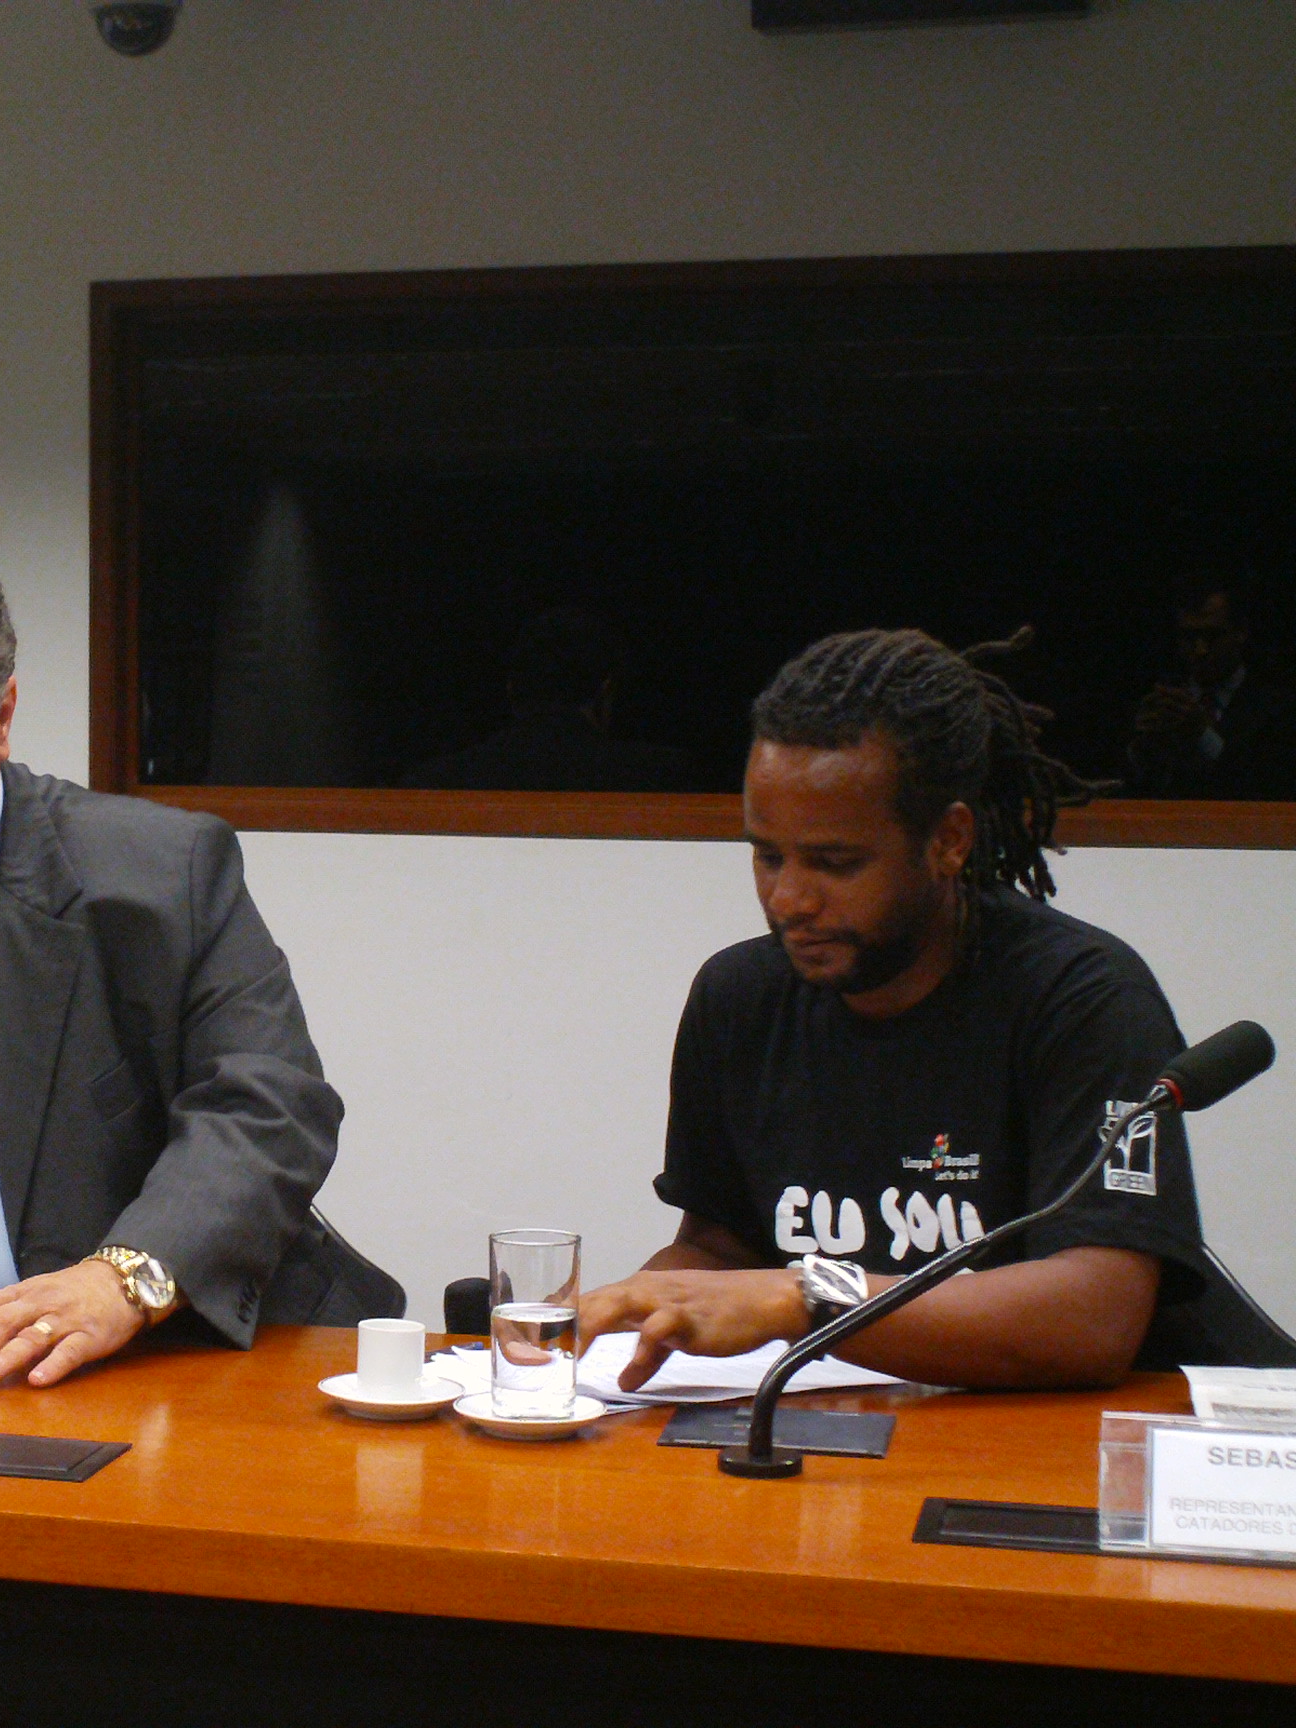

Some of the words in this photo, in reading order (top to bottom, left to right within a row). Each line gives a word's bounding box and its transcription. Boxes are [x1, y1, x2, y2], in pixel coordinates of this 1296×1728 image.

[775, 1185, 866, 1255] EU
[1207, 1446, 1296, 1470] SEBAS
[1175, 1515, 1284, 1536] CATADORES
